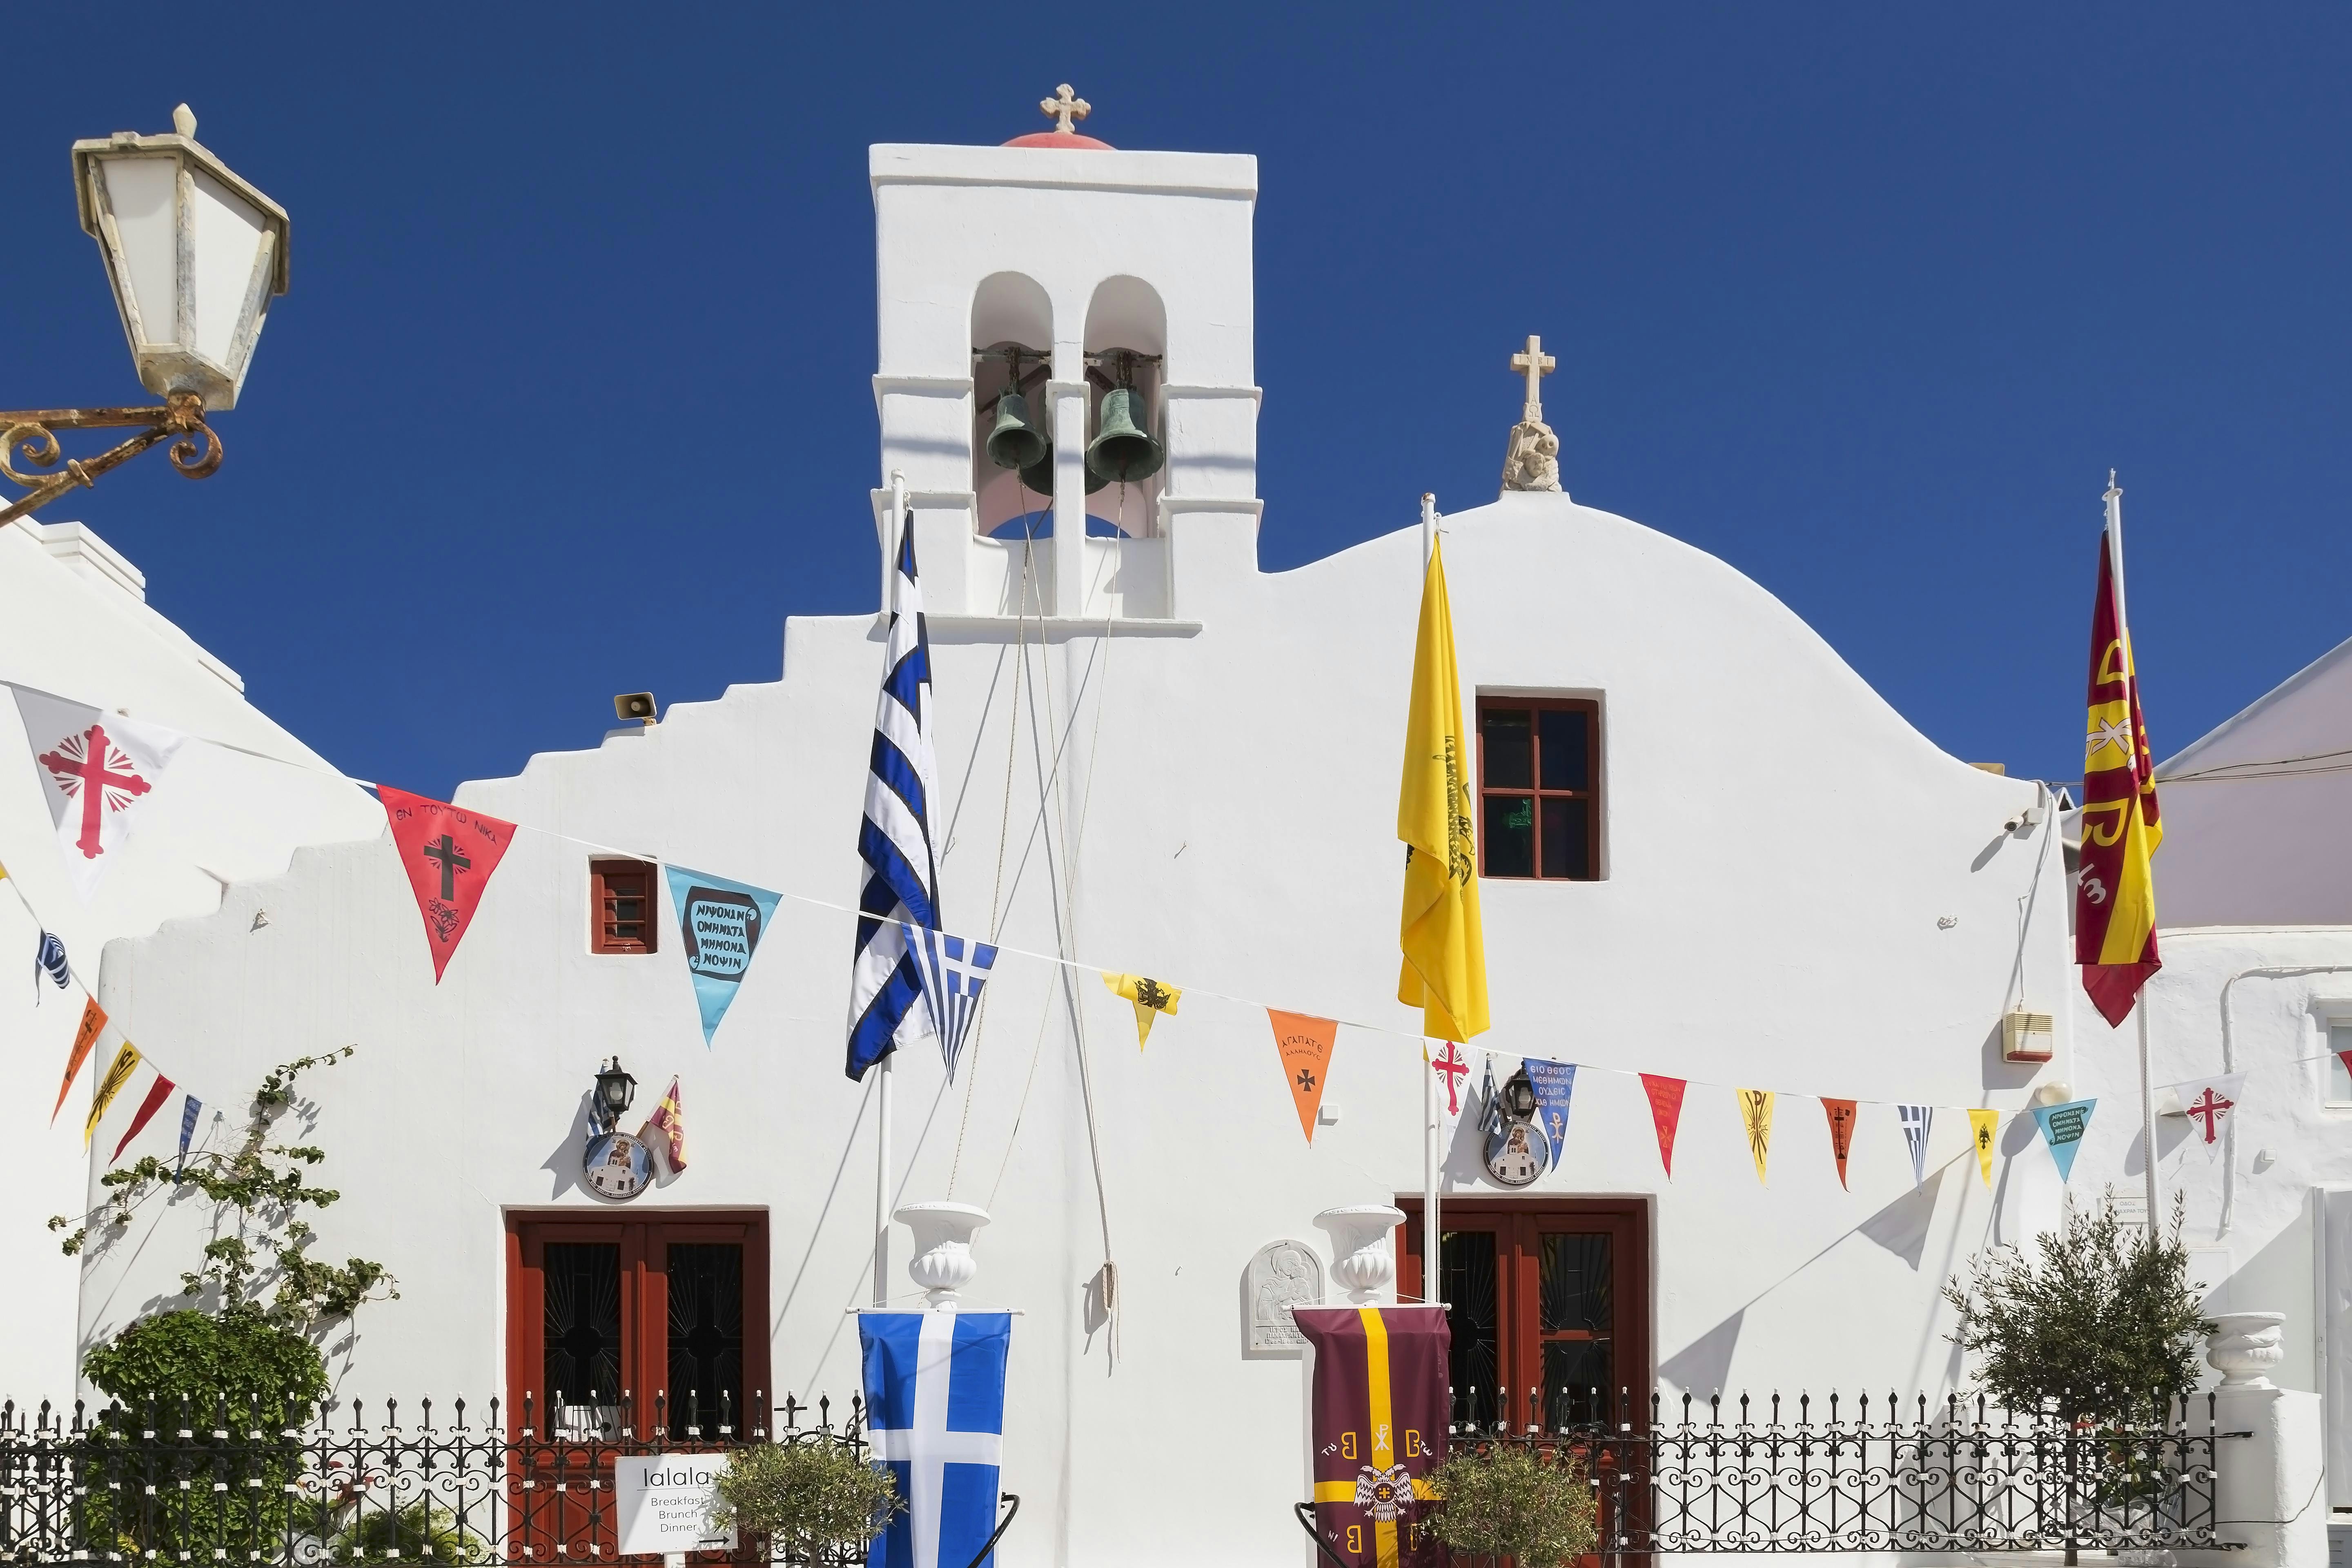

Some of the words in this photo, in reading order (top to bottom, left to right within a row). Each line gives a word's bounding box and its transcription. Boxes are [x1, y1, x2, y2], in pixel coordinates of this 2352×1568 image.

[644, 1467, 709, 1487] lalala
[651, 1496, 704, 1507] Breakfast
[659, 1509, 697, 1519] Brunch
[660, 1523, 697, 1532] Dinner
